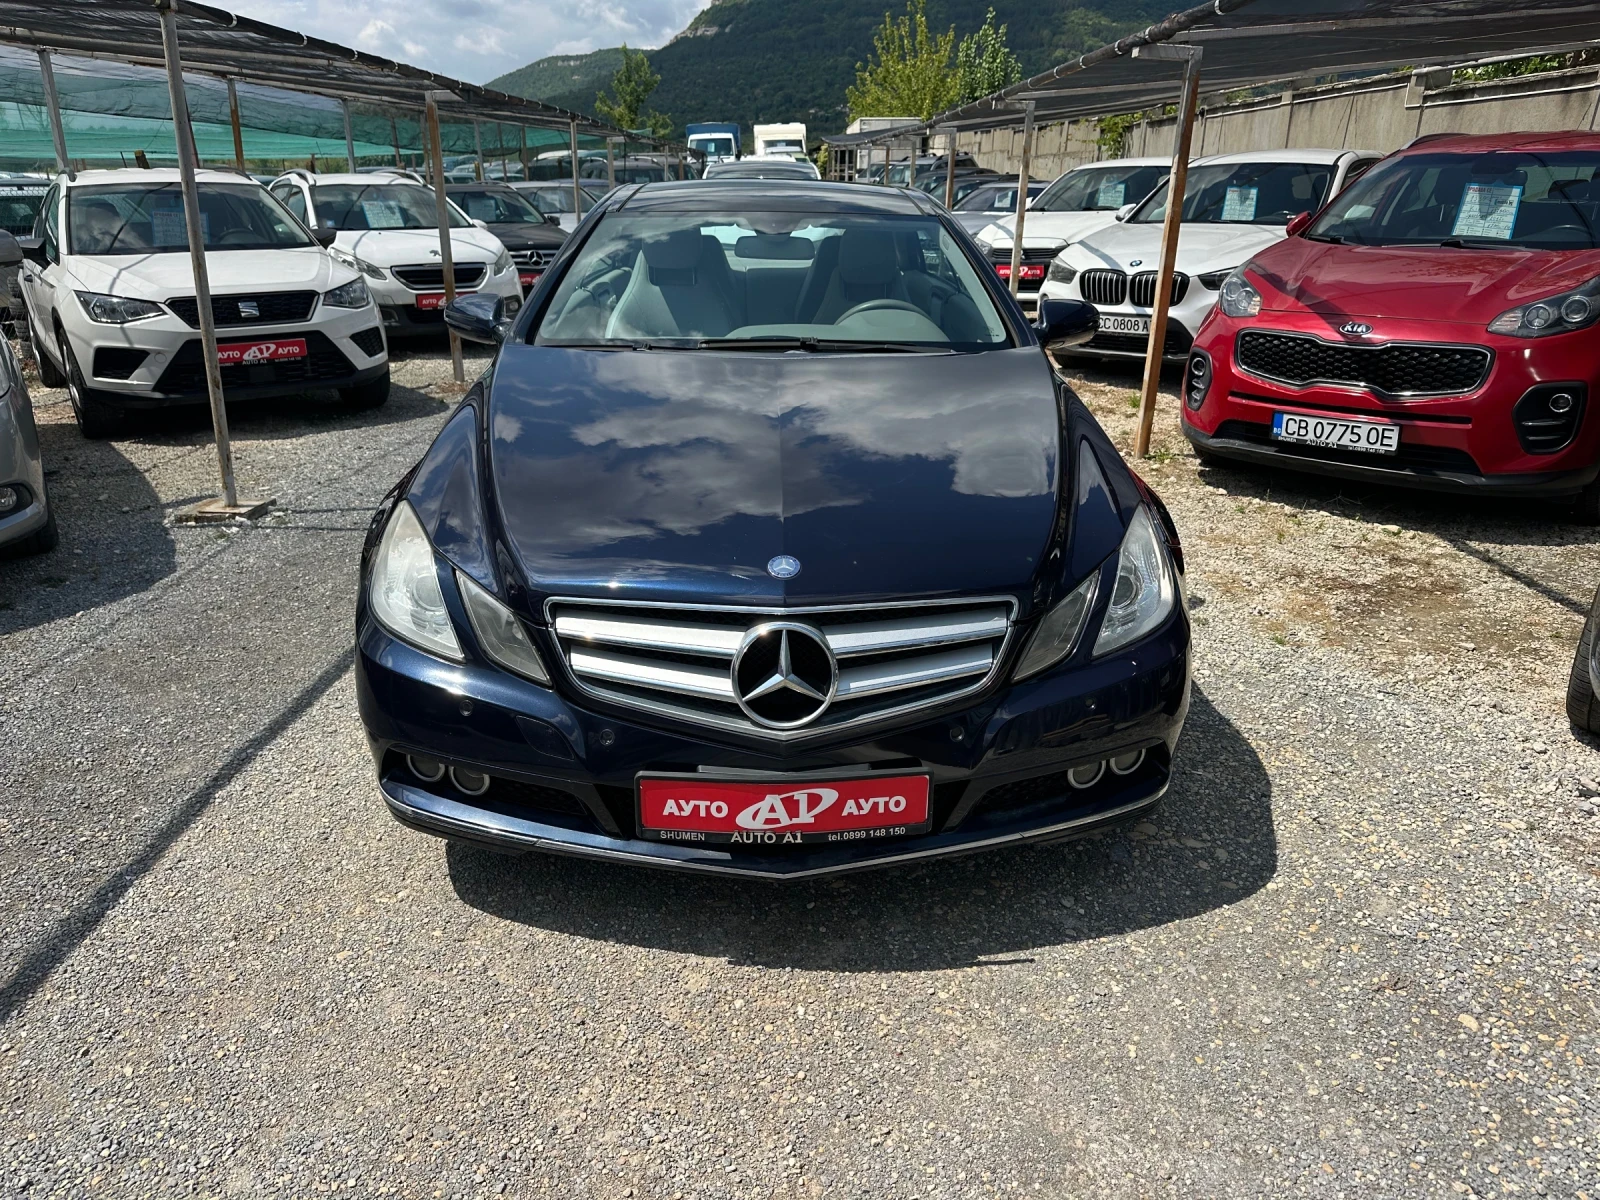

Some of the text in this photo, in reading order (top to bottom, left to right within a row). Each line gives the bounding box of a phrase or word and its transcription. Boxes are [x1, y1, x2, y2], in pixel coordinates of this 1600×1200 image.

[1112, 318, 1140, 332] 0808
[1141, 319, 1152, 332] A
[1343, 321, 1367, 333] KIA
[1285, 417, 1309, 437] CB
[1313, 421, 1362, 444] 0775
[1306, 439, 1326, 447] AUTO
[1328, 441, 1338, 449] A1
[660, 827, 906, 844] SHUMEN AUTO A1 tel.0899 148 150
